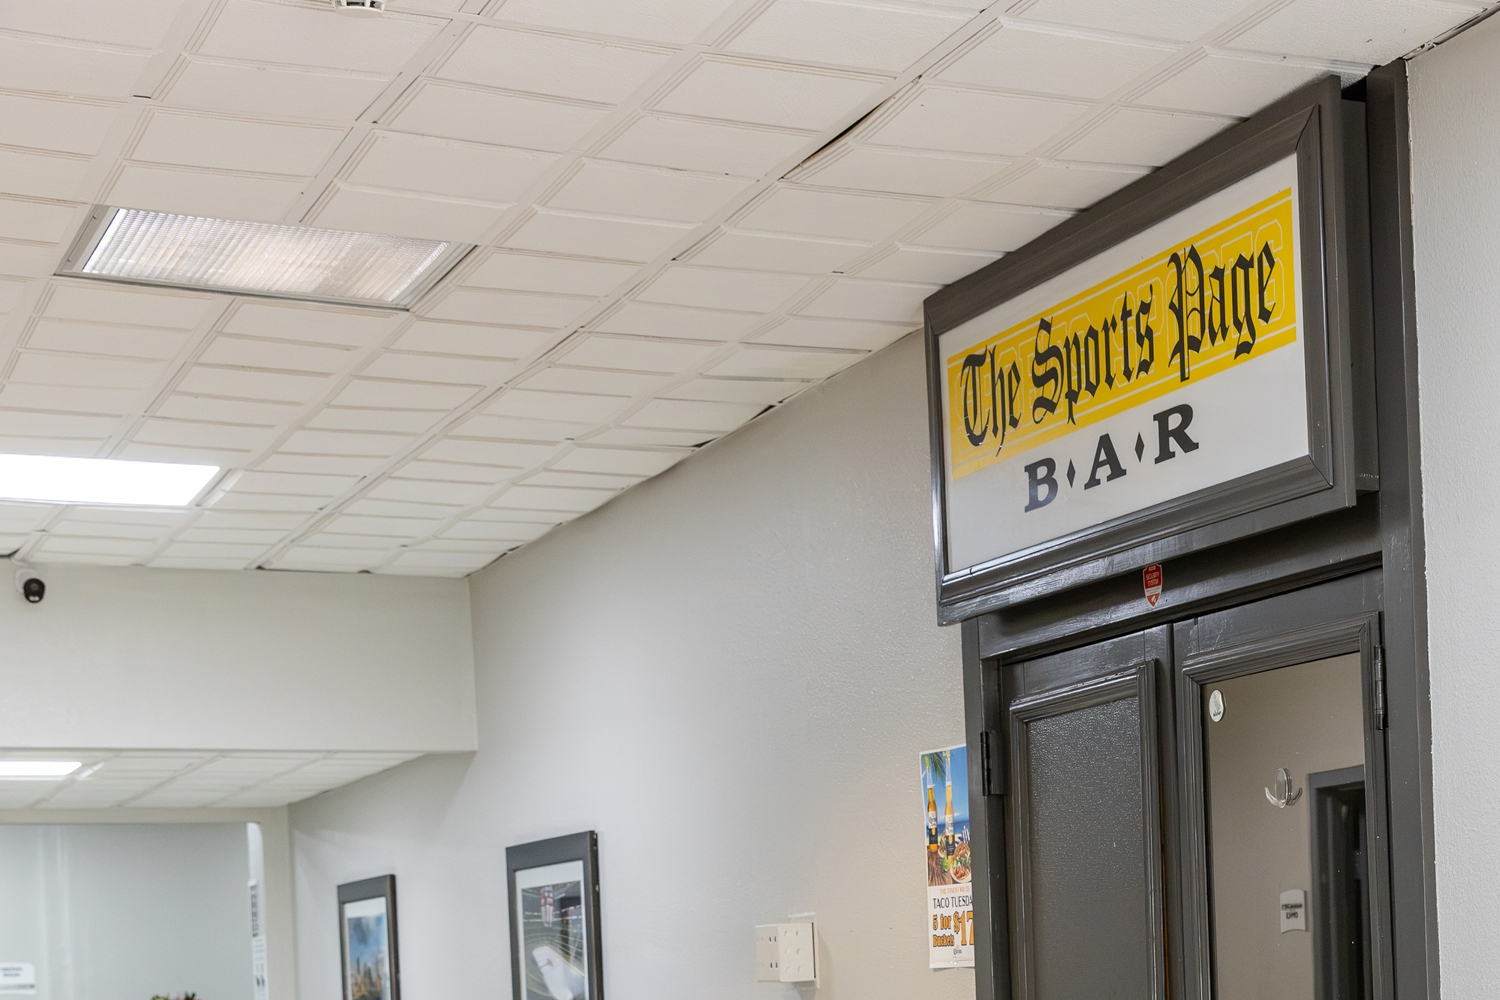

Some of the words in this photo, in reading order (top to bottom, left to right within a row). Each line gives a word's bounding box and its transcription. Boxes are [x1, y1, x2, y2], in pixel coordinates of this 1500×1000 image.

[960, 344, 1022, 457] The
[1031, 284, 1155, 426] Sports
[1167, 241, 1276, 382] Page
[932, 897, 950, 909] TACO
[933, 914, 939, 930] 5
